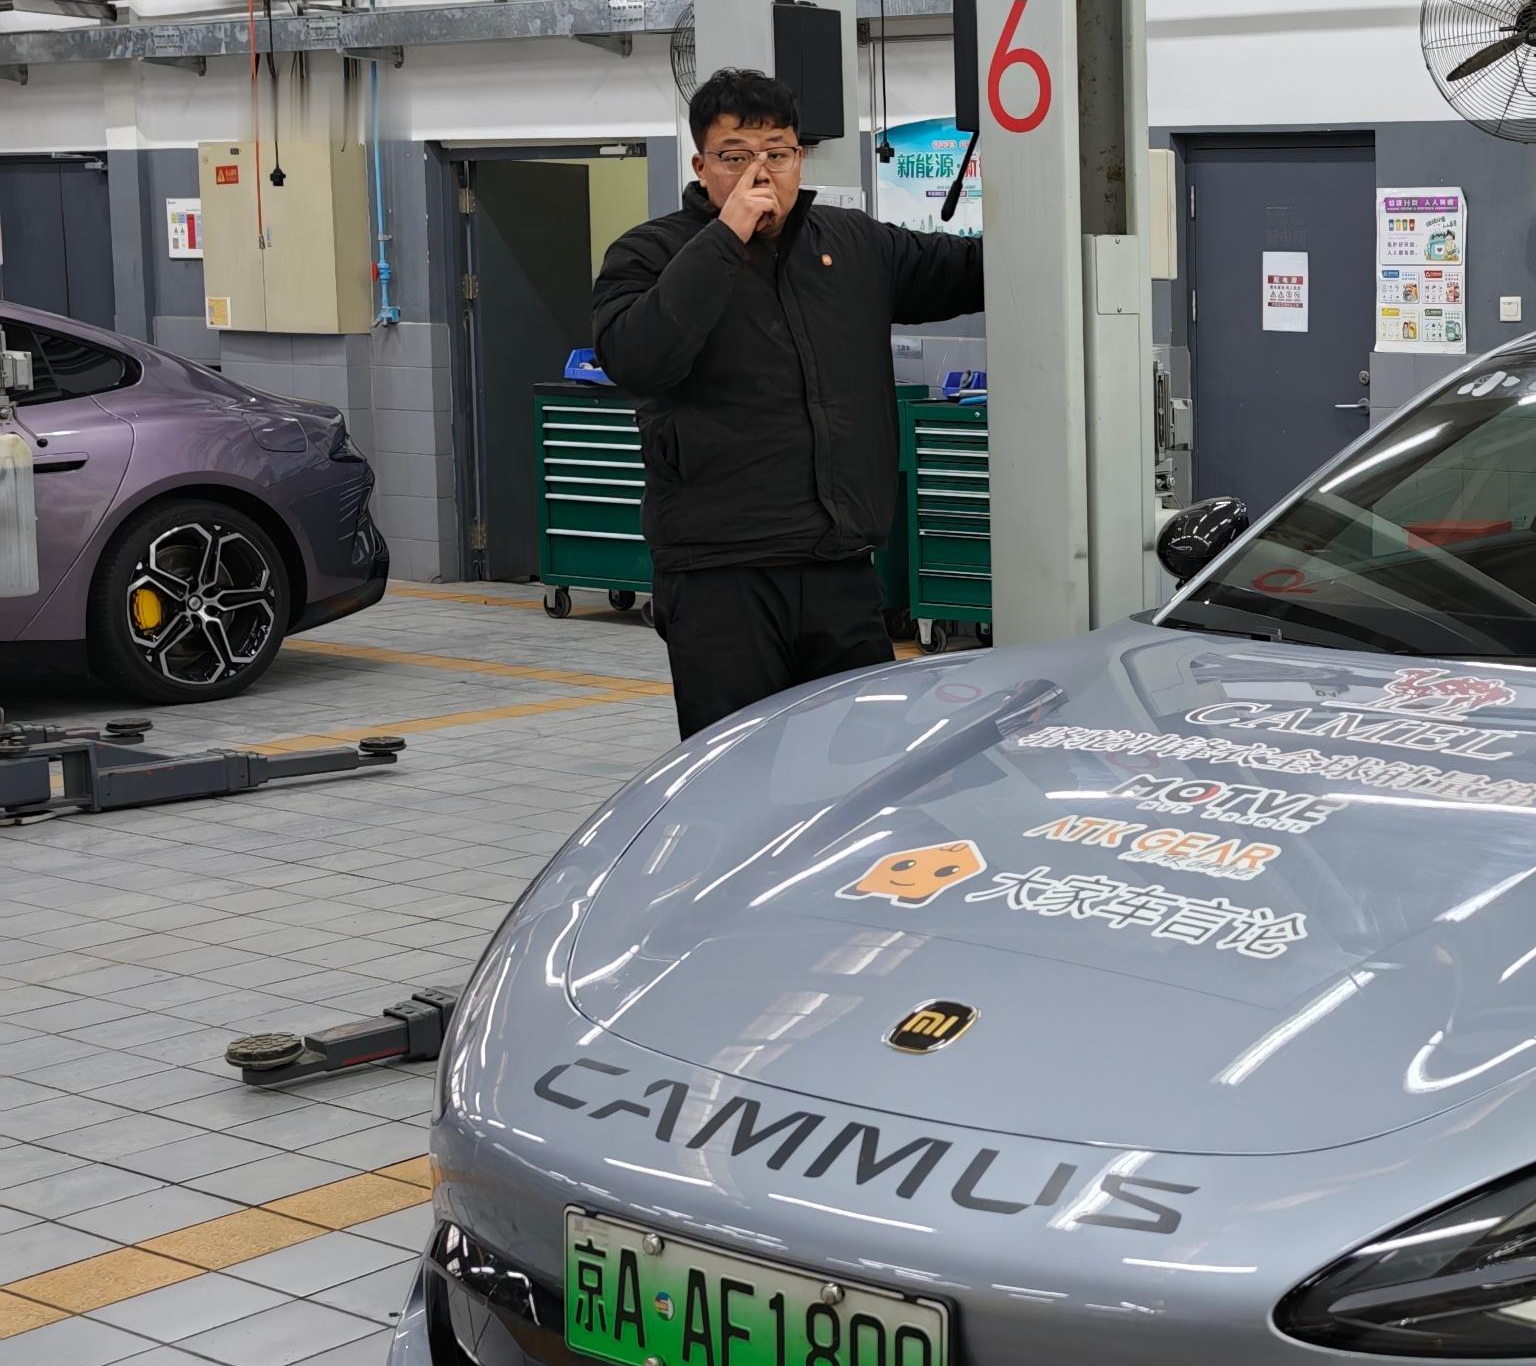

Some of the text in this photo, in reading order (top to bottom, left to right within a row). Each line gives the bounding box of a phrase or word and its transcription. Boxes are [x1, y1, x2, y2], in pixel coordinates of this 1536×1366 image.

[1185, 701, 1518, 760] CAMEL
[1025, 815, 1147, 847] ATK
[1131, 828, 1282, 870] GEAR
[966, 865, 1307, 959] 大家车言论
[533, 1057, 1200, 1234] CAMMUS
